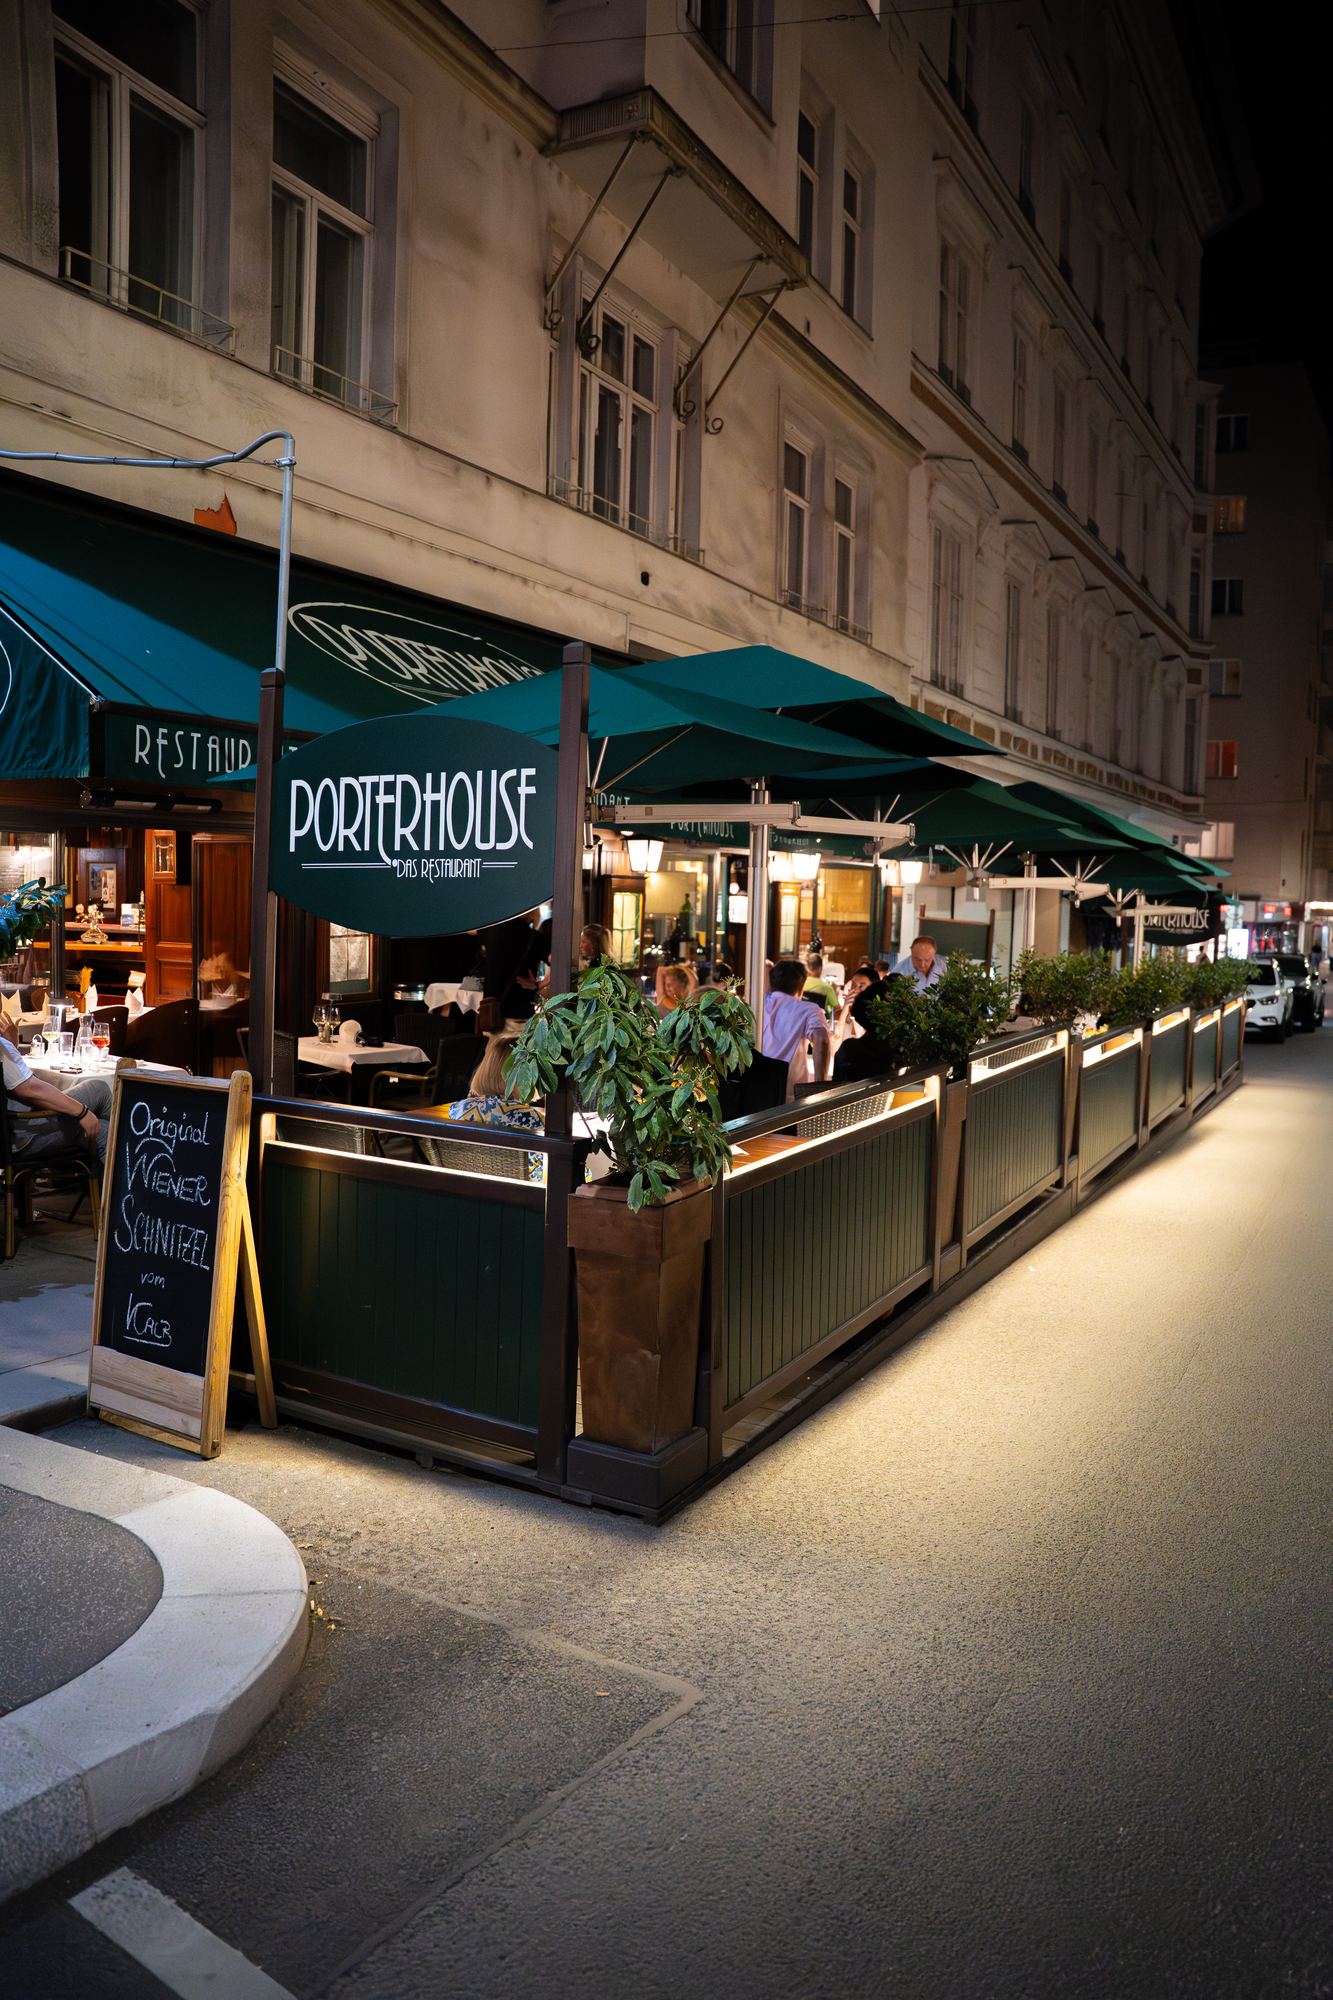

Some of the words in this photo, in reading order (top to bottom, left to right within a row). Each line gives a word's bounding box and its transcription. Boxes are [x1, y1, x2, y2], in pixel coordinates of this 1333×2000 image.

[297, 613, 546, 694] PORTERHO
[289, 767, 537, 866] PORTERHOUSE
[396, 859, 418, 878] DAS
[421, 858, 482, 883] RESTAURANT
[130, 1101, 210, 1153] Original
[126, 1141, 211, 1206] WIENER
[114, 1194, 210, 1271] SCHNITZEL
[140, 1273, 165, 1288] vom
